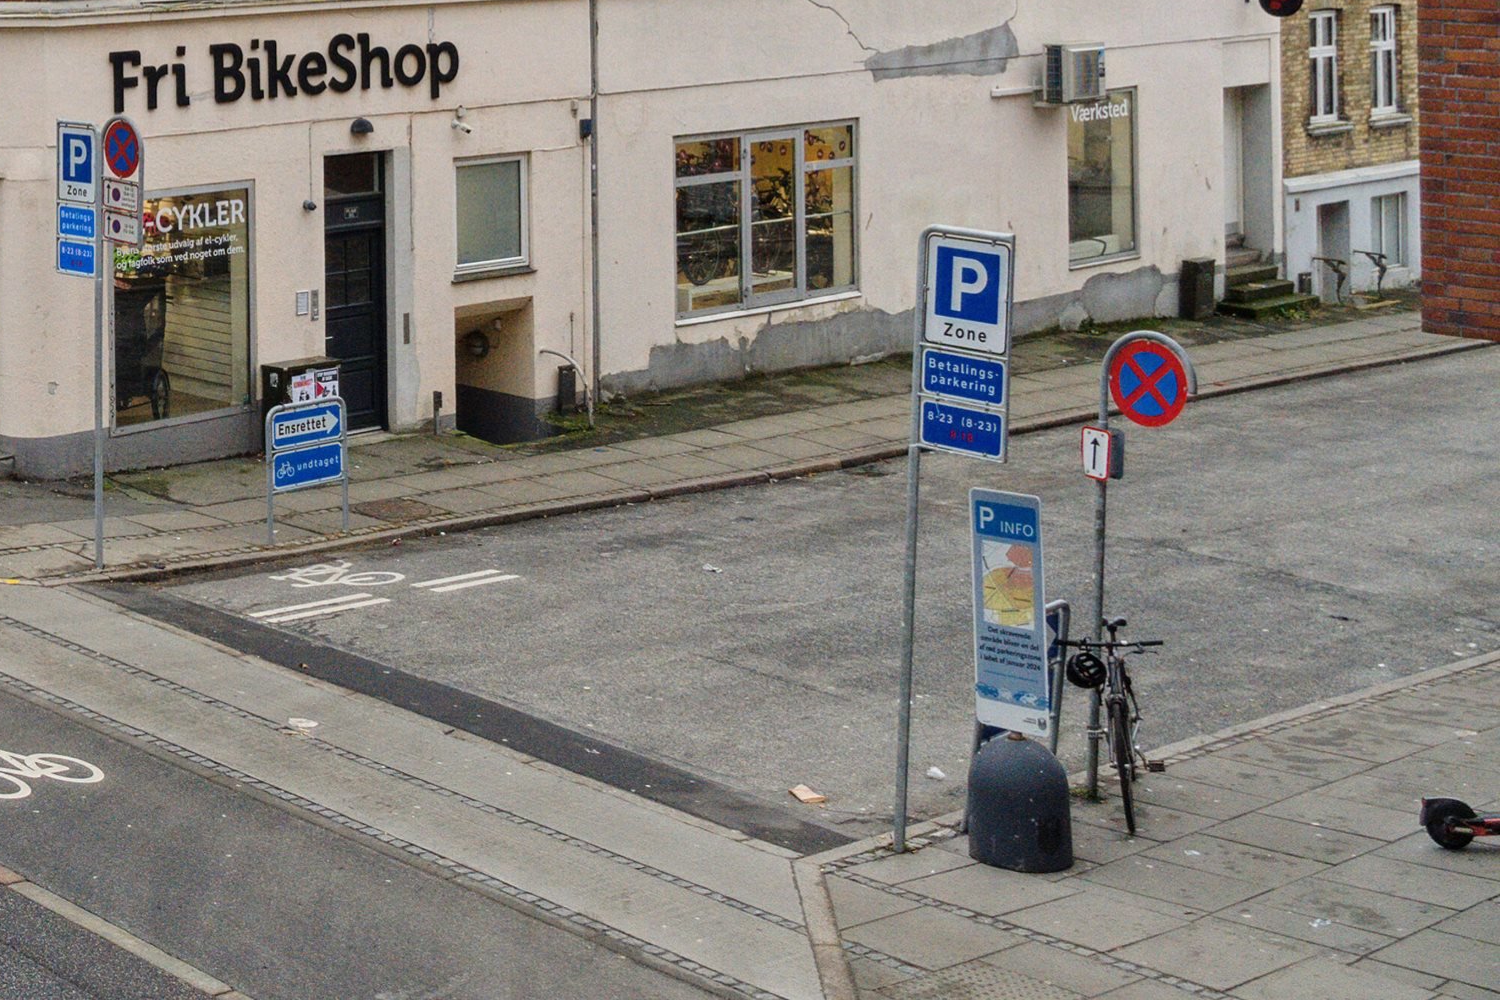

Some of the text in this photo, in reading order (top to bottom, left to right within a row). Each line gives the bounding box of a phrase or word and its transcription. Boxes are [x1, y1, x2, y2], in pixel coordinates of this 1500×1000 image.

[109, 33, 459, 113] Fri BikeShop
[1071, 98, 1129, 122] Værksted
[67, 185, 88, 198] Zone
[143, 199, 245, 233] -CYKLER
[62, 222, 92, 235] parkering
[116, 245, 139, 257] Byens
[169, 236, 194, 250] udvalg
[196, 236, 204, 246] af
[116, 261, 127, 272] og
[128, 256, 155, 270] fagfolk
[157, 254, 174, 264] som
[174, 250, 189, 261] ved
[190, 248, 212, 262] noget
[213, 247, 226, 257] om
[944, 322, 988, 343] Zone
[929, 357, 999, 380] Betalings-
[931, 373, 996, 397] parkering
[278, 416, 327, 436] Ensrettet
[928, 410, 997, 433] 8-23 (8-23)
[297, 455, 339, 471] undtaget
[980, 506, 1034, 537] P INFO
[988, 626, 998, 634] Det
